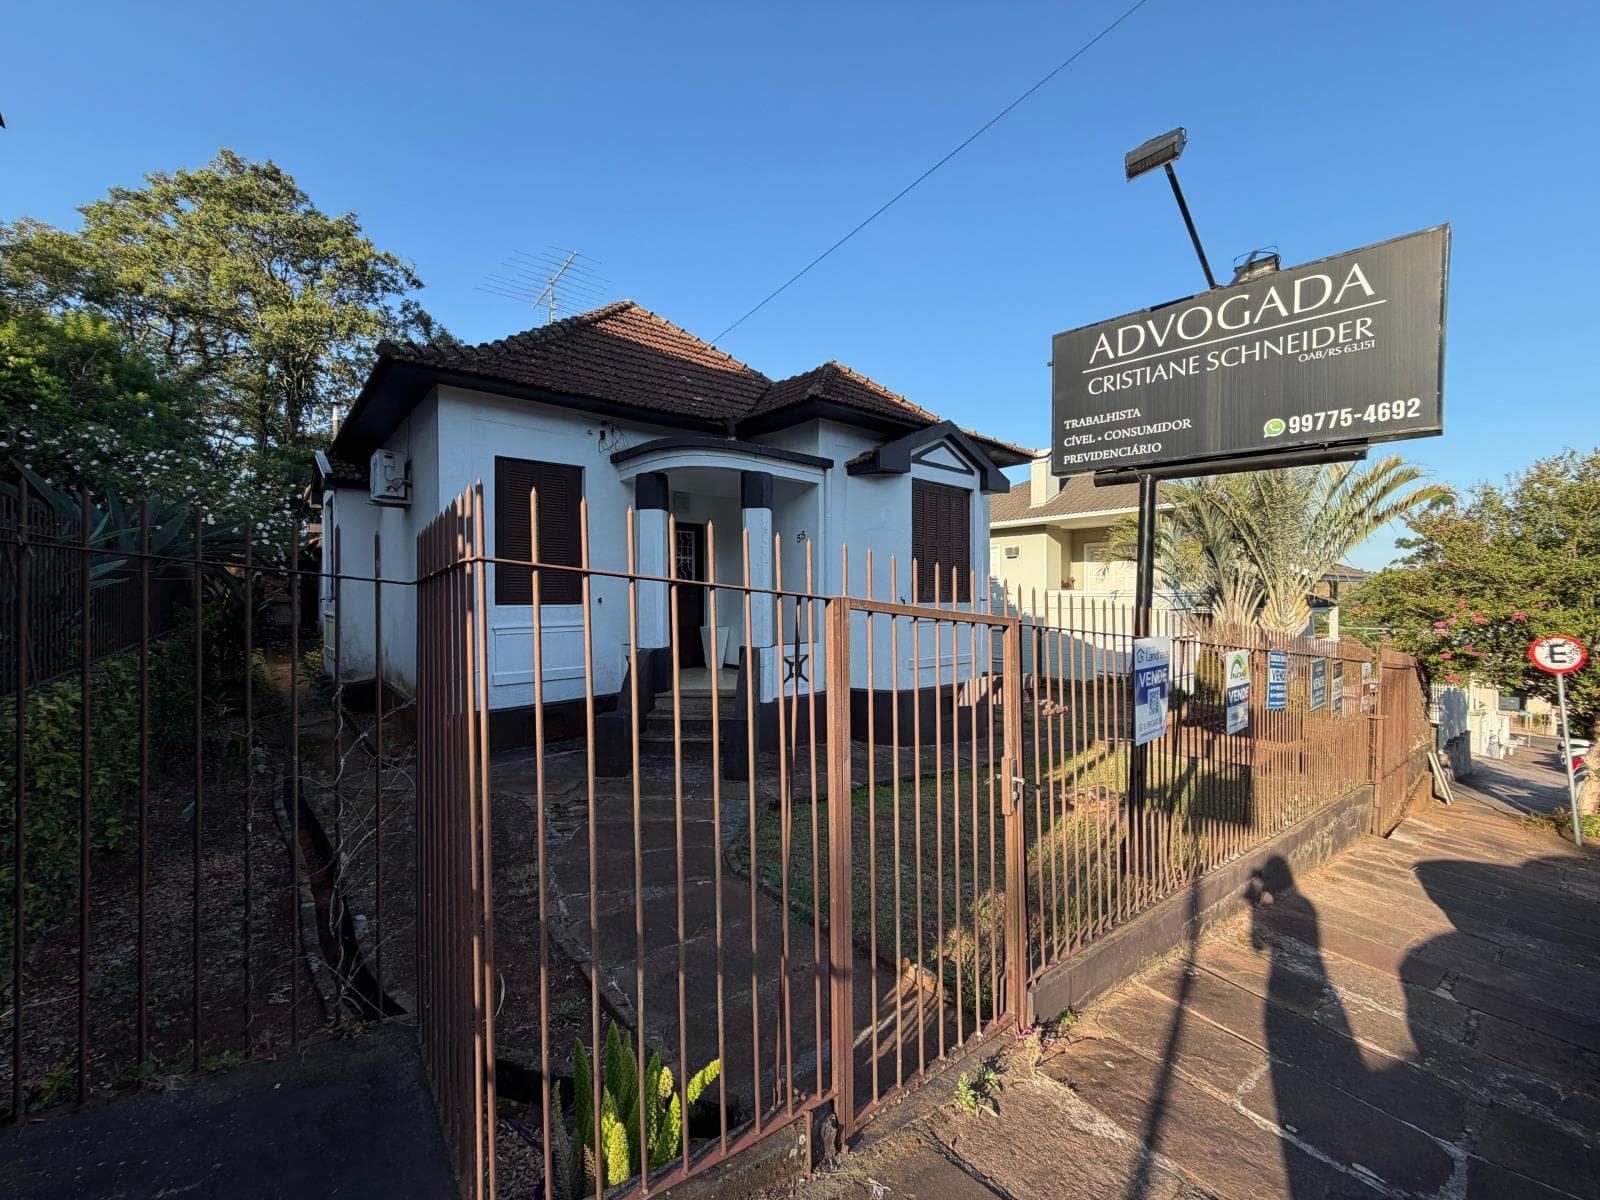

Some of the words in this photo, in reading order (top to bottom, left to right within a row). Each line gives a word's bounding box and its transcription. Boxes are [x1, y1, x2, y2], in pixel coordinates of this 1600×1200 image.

[1088, 262, 1376, 365] ADVOGADA
[1088, 355, 1200, 395] CRISTIANE
[1206, 317, 1375, 372] SCHNEIDER
[1298, 346, 1343, 363] OAB/RS
[1343, 339, 1376, 354] 63.151
[1063, 407, 1142, 430] TRABALHISTA
[1288, 397, 1421, 434] 99775-4692
[1063, 434, 1096, 447] CÍVEL
[1104, 418, 1193, 441] CONSUMIDOR
[1063, 442, 1162, 465] PREVIDENCIÁRIO
[1549, 643, 1568, 664] E
[1138, 667, 1168, 688] VENDE
